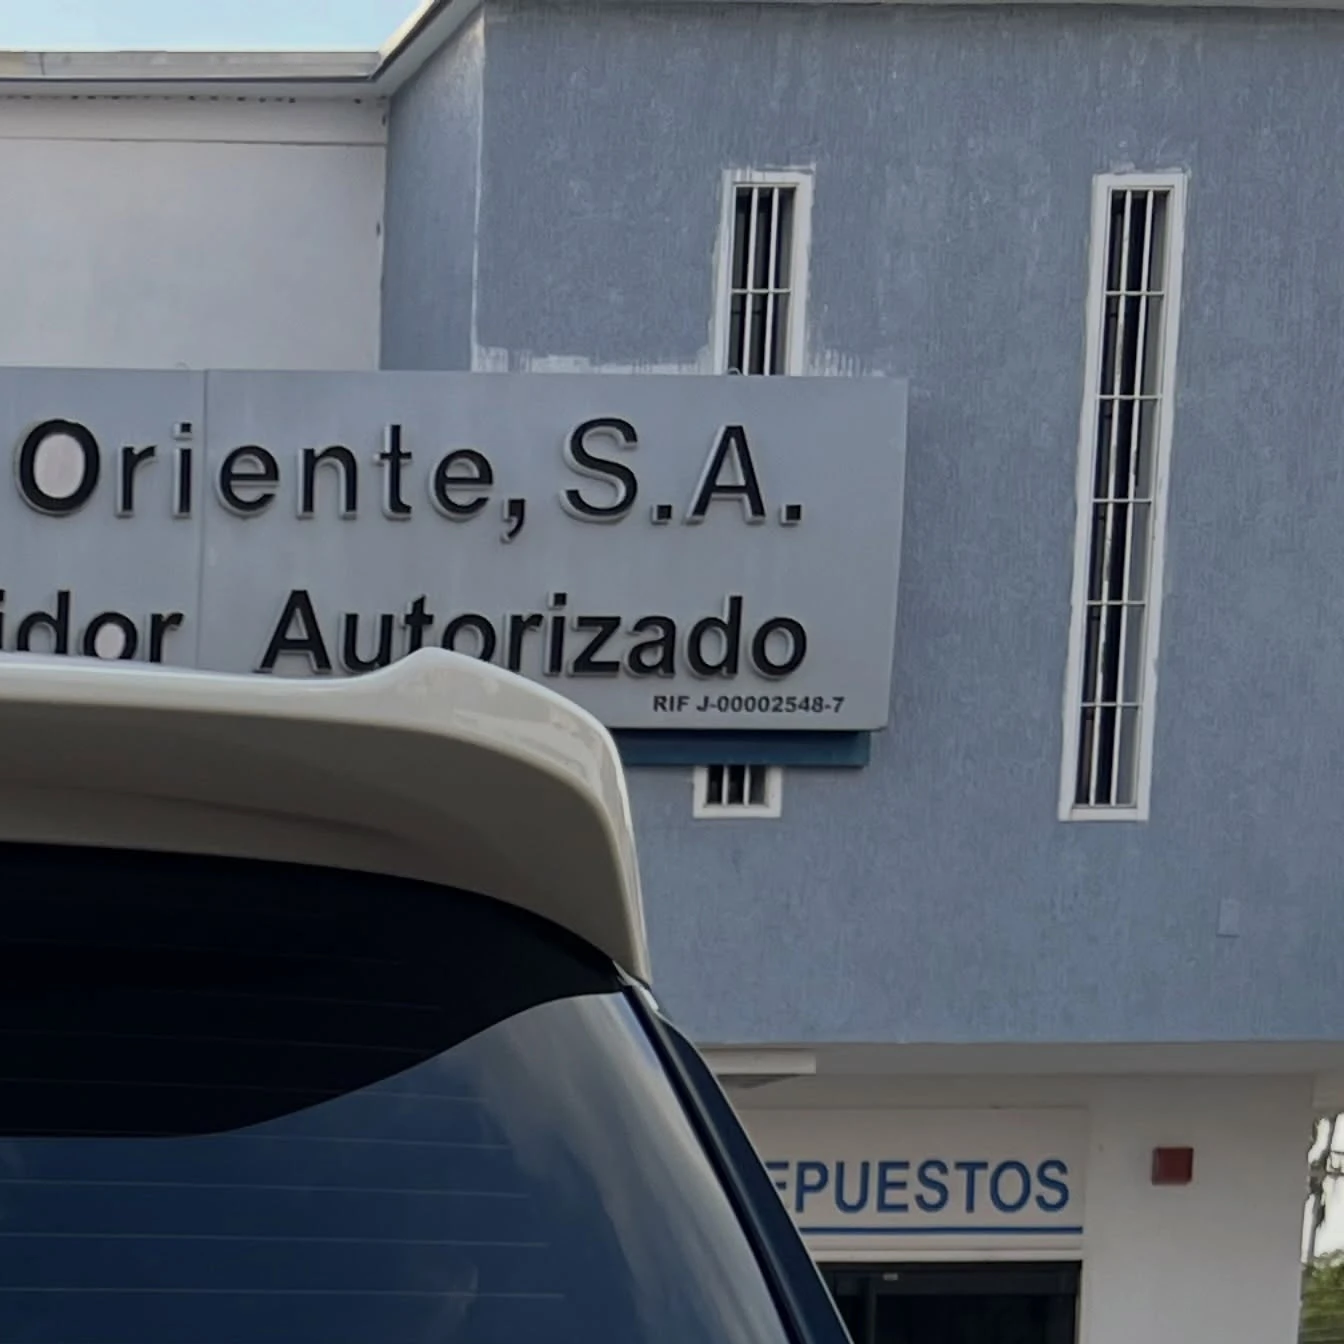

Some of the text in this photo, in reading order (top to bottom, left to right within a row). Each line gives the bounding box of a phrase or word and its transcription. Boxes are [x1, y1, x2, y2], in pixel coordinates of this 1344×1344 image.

[15, 418, 527, 543] Oriente,
[559, 417, 803, 526] S.A.
[256, 589, 808, 677] Autorizado
[652, 695, 846, 714] RIF J-00002548-7
